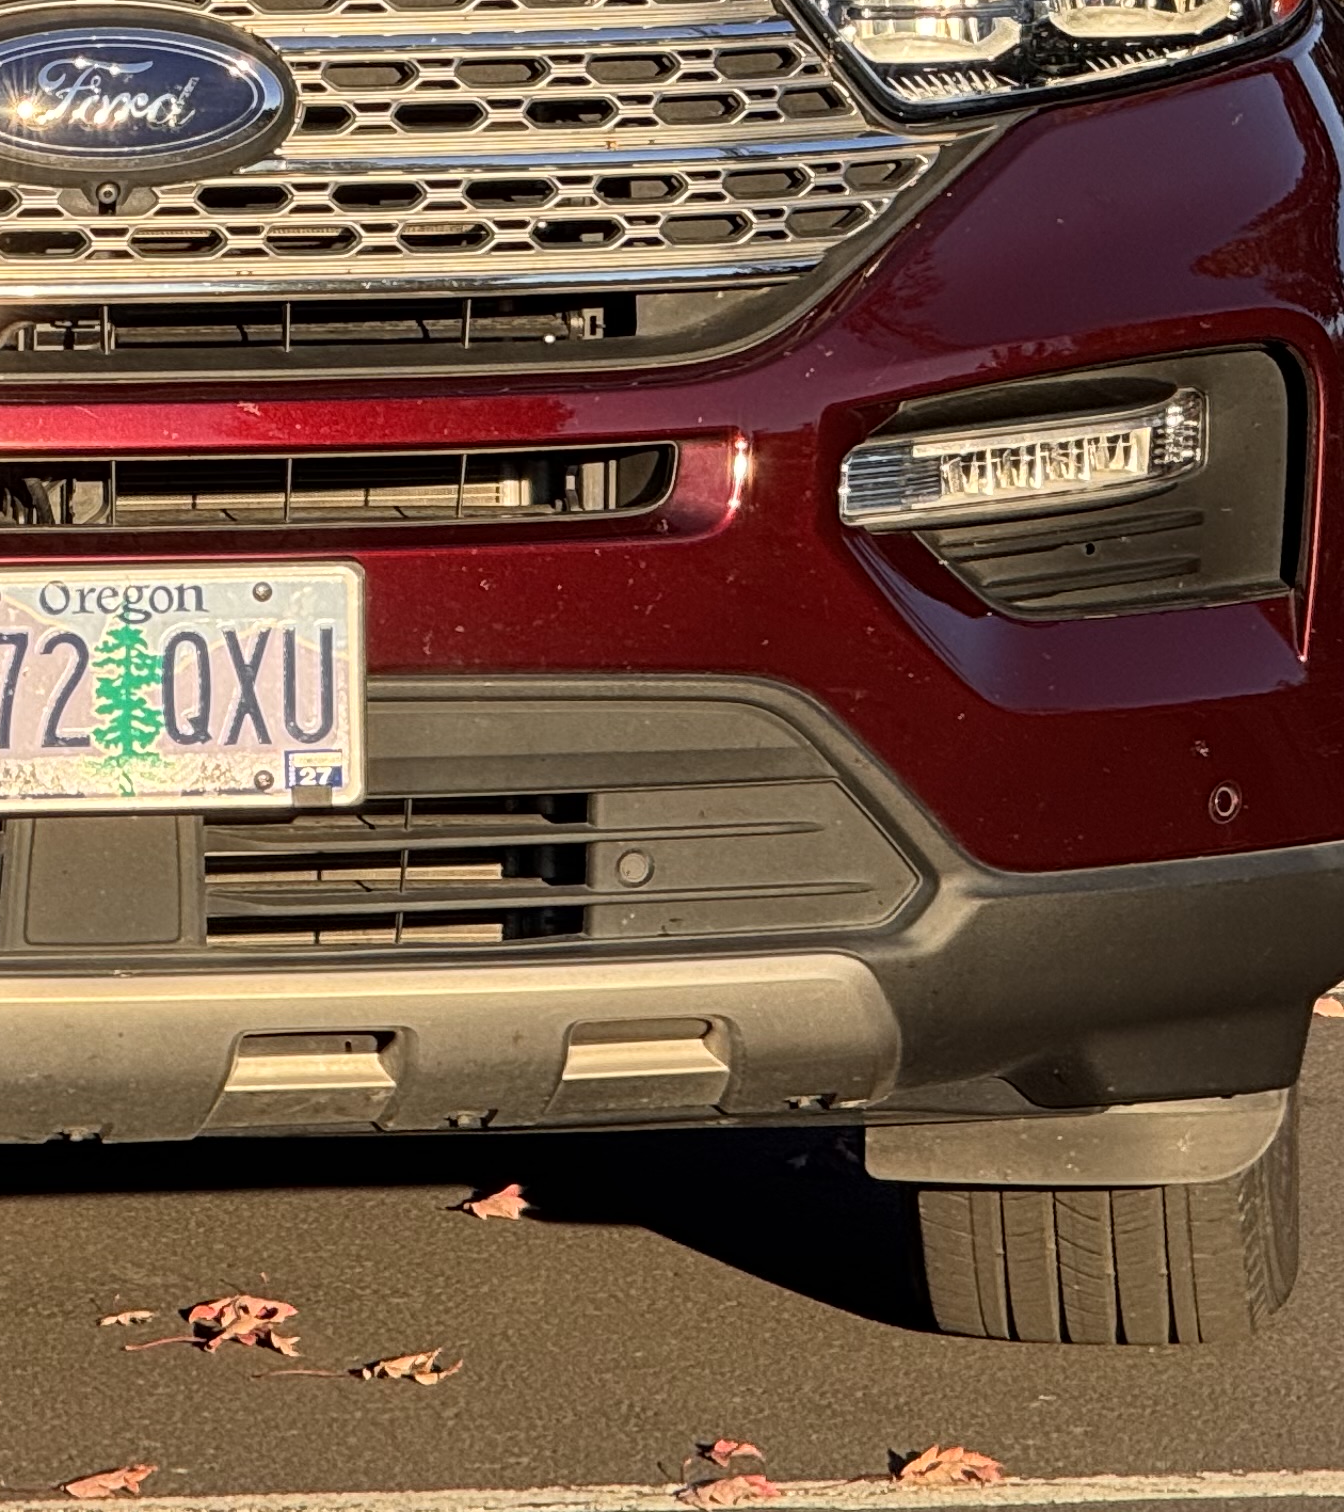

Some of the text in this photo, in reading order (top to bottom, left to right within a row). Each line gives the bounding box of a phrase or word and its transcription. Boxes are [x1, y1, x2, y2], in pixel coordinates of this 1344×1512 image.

[26, 56, 200, 130] Ford
[38, 580, 209, 624] Oregon
[162, 624, 334, 746] QXU
[299, 766, 333, 785] 27
